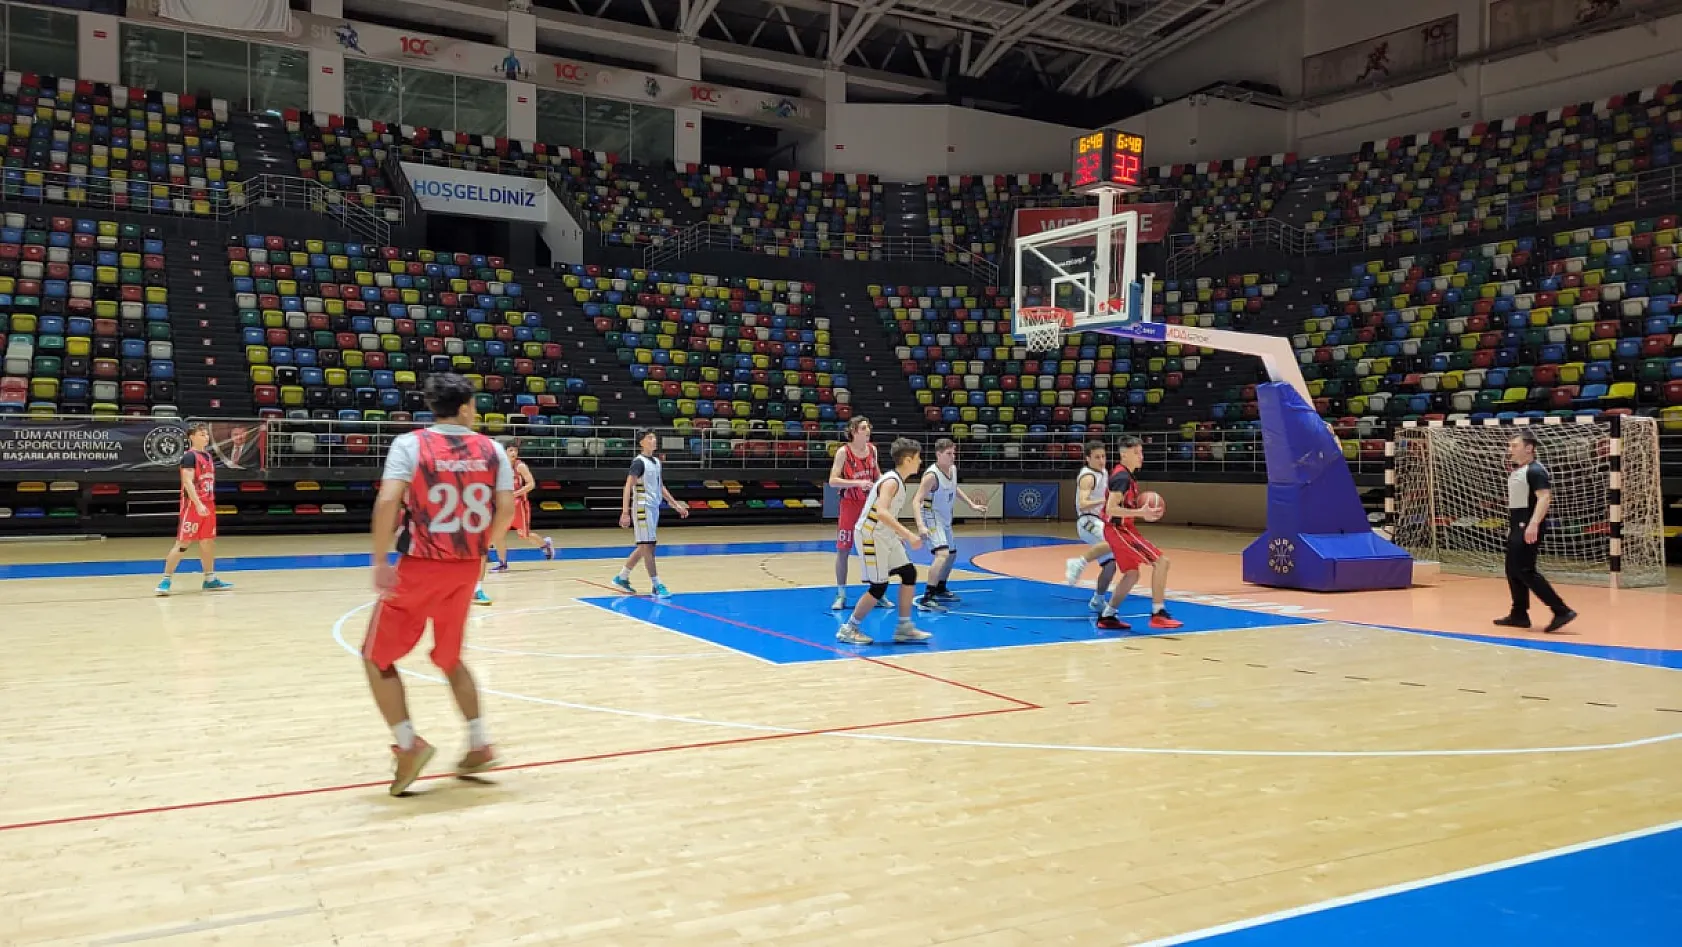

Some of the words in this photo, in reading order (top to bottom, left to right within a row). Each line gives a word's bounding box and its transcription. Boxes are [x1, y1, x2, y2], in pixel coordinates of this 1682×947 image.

[1079, 133, 1103, 153] 6:48
[1116, 133, 1142, 153] 6:48
[1112, 153, 1139, 183] 32
[412, 178, 536, 207] HOŞGELDİNİZ
[13, 428, 44, 440] TÜM
[0, 440, 14, 450] VE
[17, 440, 122, 451] SPORCULARIMIZA
[3, 451, 61, 461] BAŞARILAR
[62, 451, 119, 461] DİLİYORUM
[427, 482, 493, 533] 28
[184, 521, 199, 534] 30
